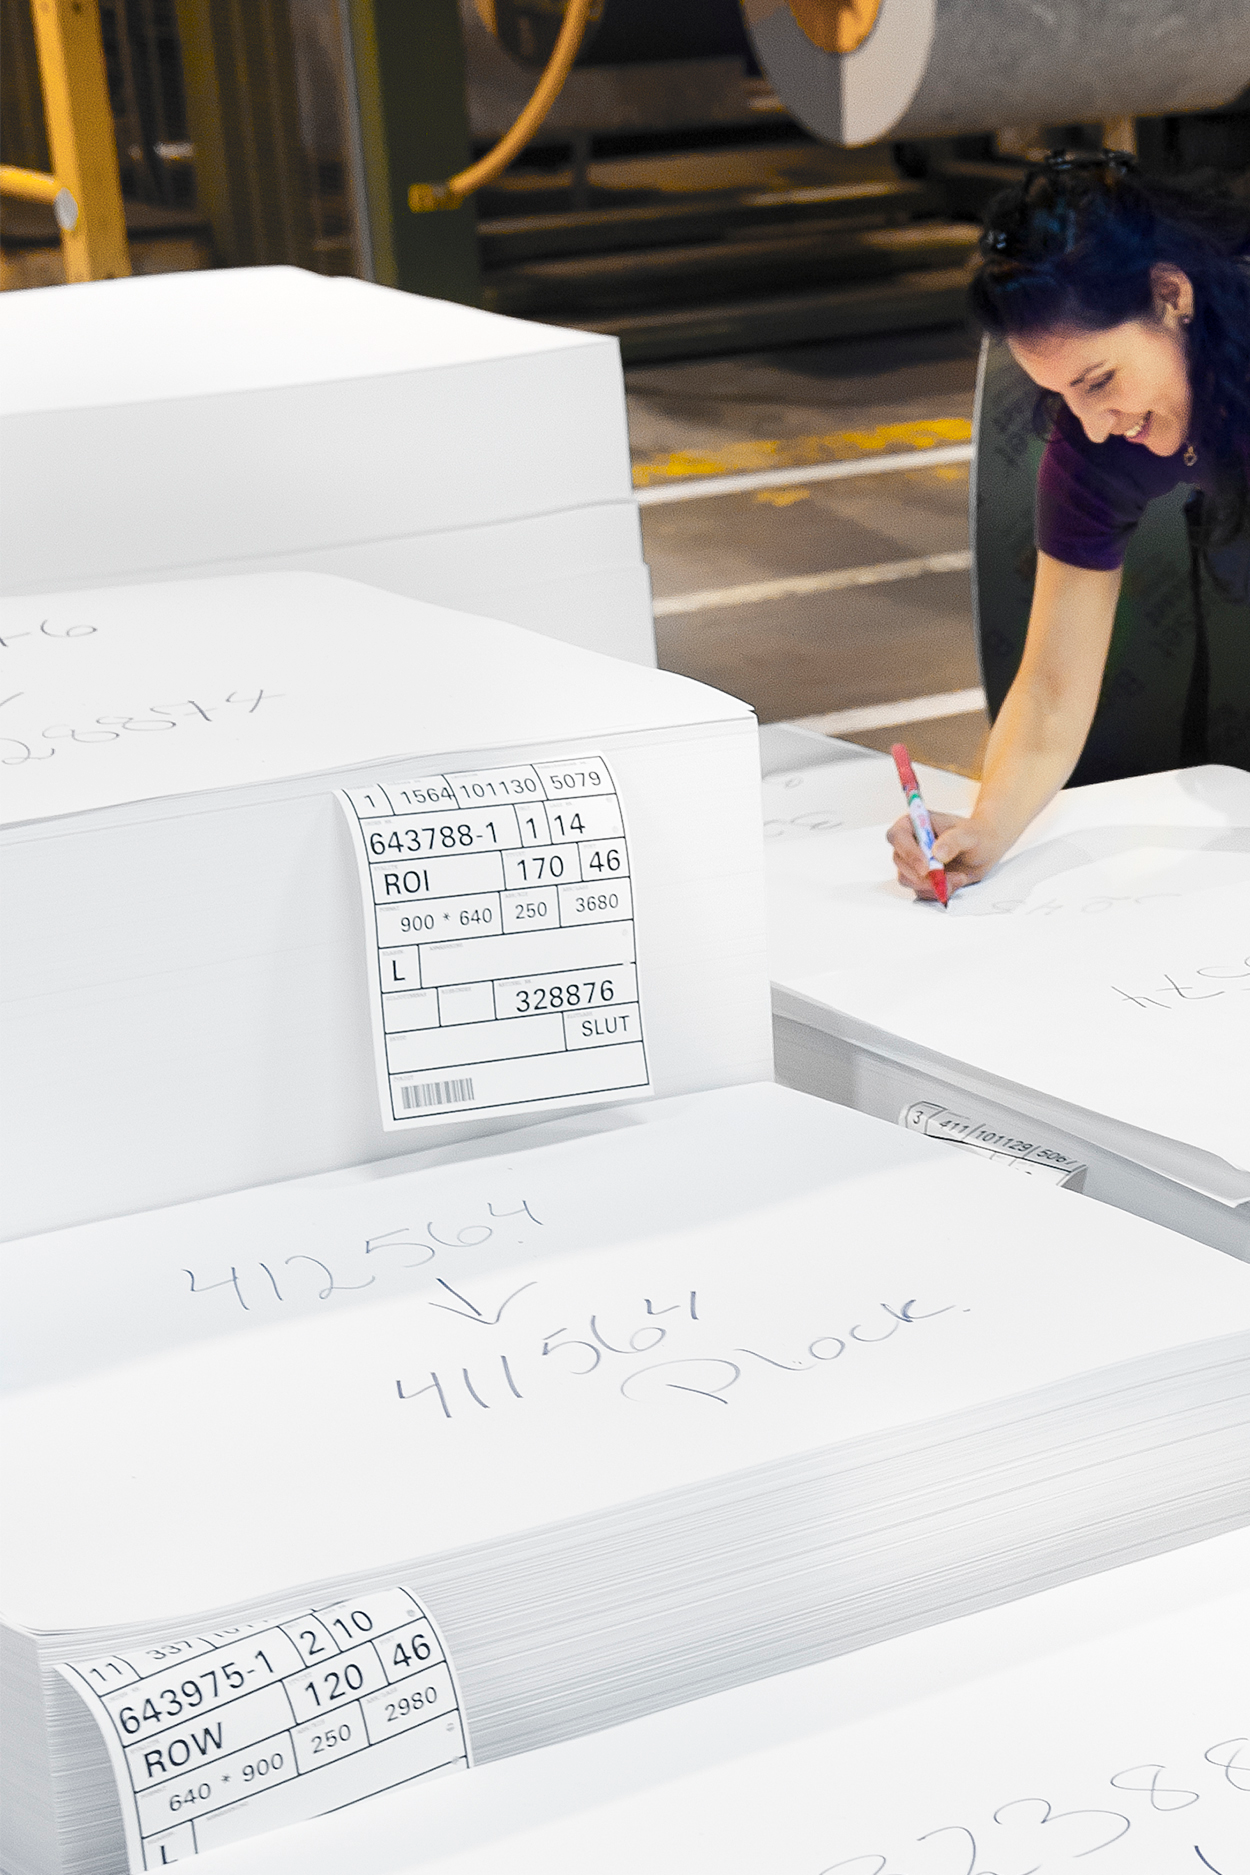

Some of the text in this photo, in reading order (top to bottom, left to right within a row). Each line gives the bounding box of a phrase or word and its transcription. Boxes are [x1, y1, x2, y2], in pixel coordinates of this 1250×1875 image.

[363, 771, 602, 808] 1 1564 101130 5079
[370, 812, 586, 855] 643788-1 1 14
[384, 849, 621, 895] ROI 170 46
[400, 915, 435, 933] 900
[459, 908, 493, 926] 640
[515, 901, 548, 920] 250
[575, 893, 619, 913] 3680
[392, 959, 406, 981] L
[516, 979, 615, 1013] 328876
[581, 1015, 630, 1037] SLUT
[912, 1110, 924, 1125] 3
[938, 1120, 970, 1135] 411
[976, 1129, 1033, 1152] 101129
[90, 1662, 122, 1682] 11
[119, 1650, 274, 1735] 643975-1
[299, 1629, 325, 1656] 2
[333, 1609, 373, 1640] 10
[144, 1632, 432, 1778] ROW 120 46
[168, 1781, 212, 1813] 640
[242, 1751, 285, 1783] 900
[311, 1723, 352, 1755] 250
[384, 1685, 438, 1722] 2980
[159, 1844, 178, 1865] L
